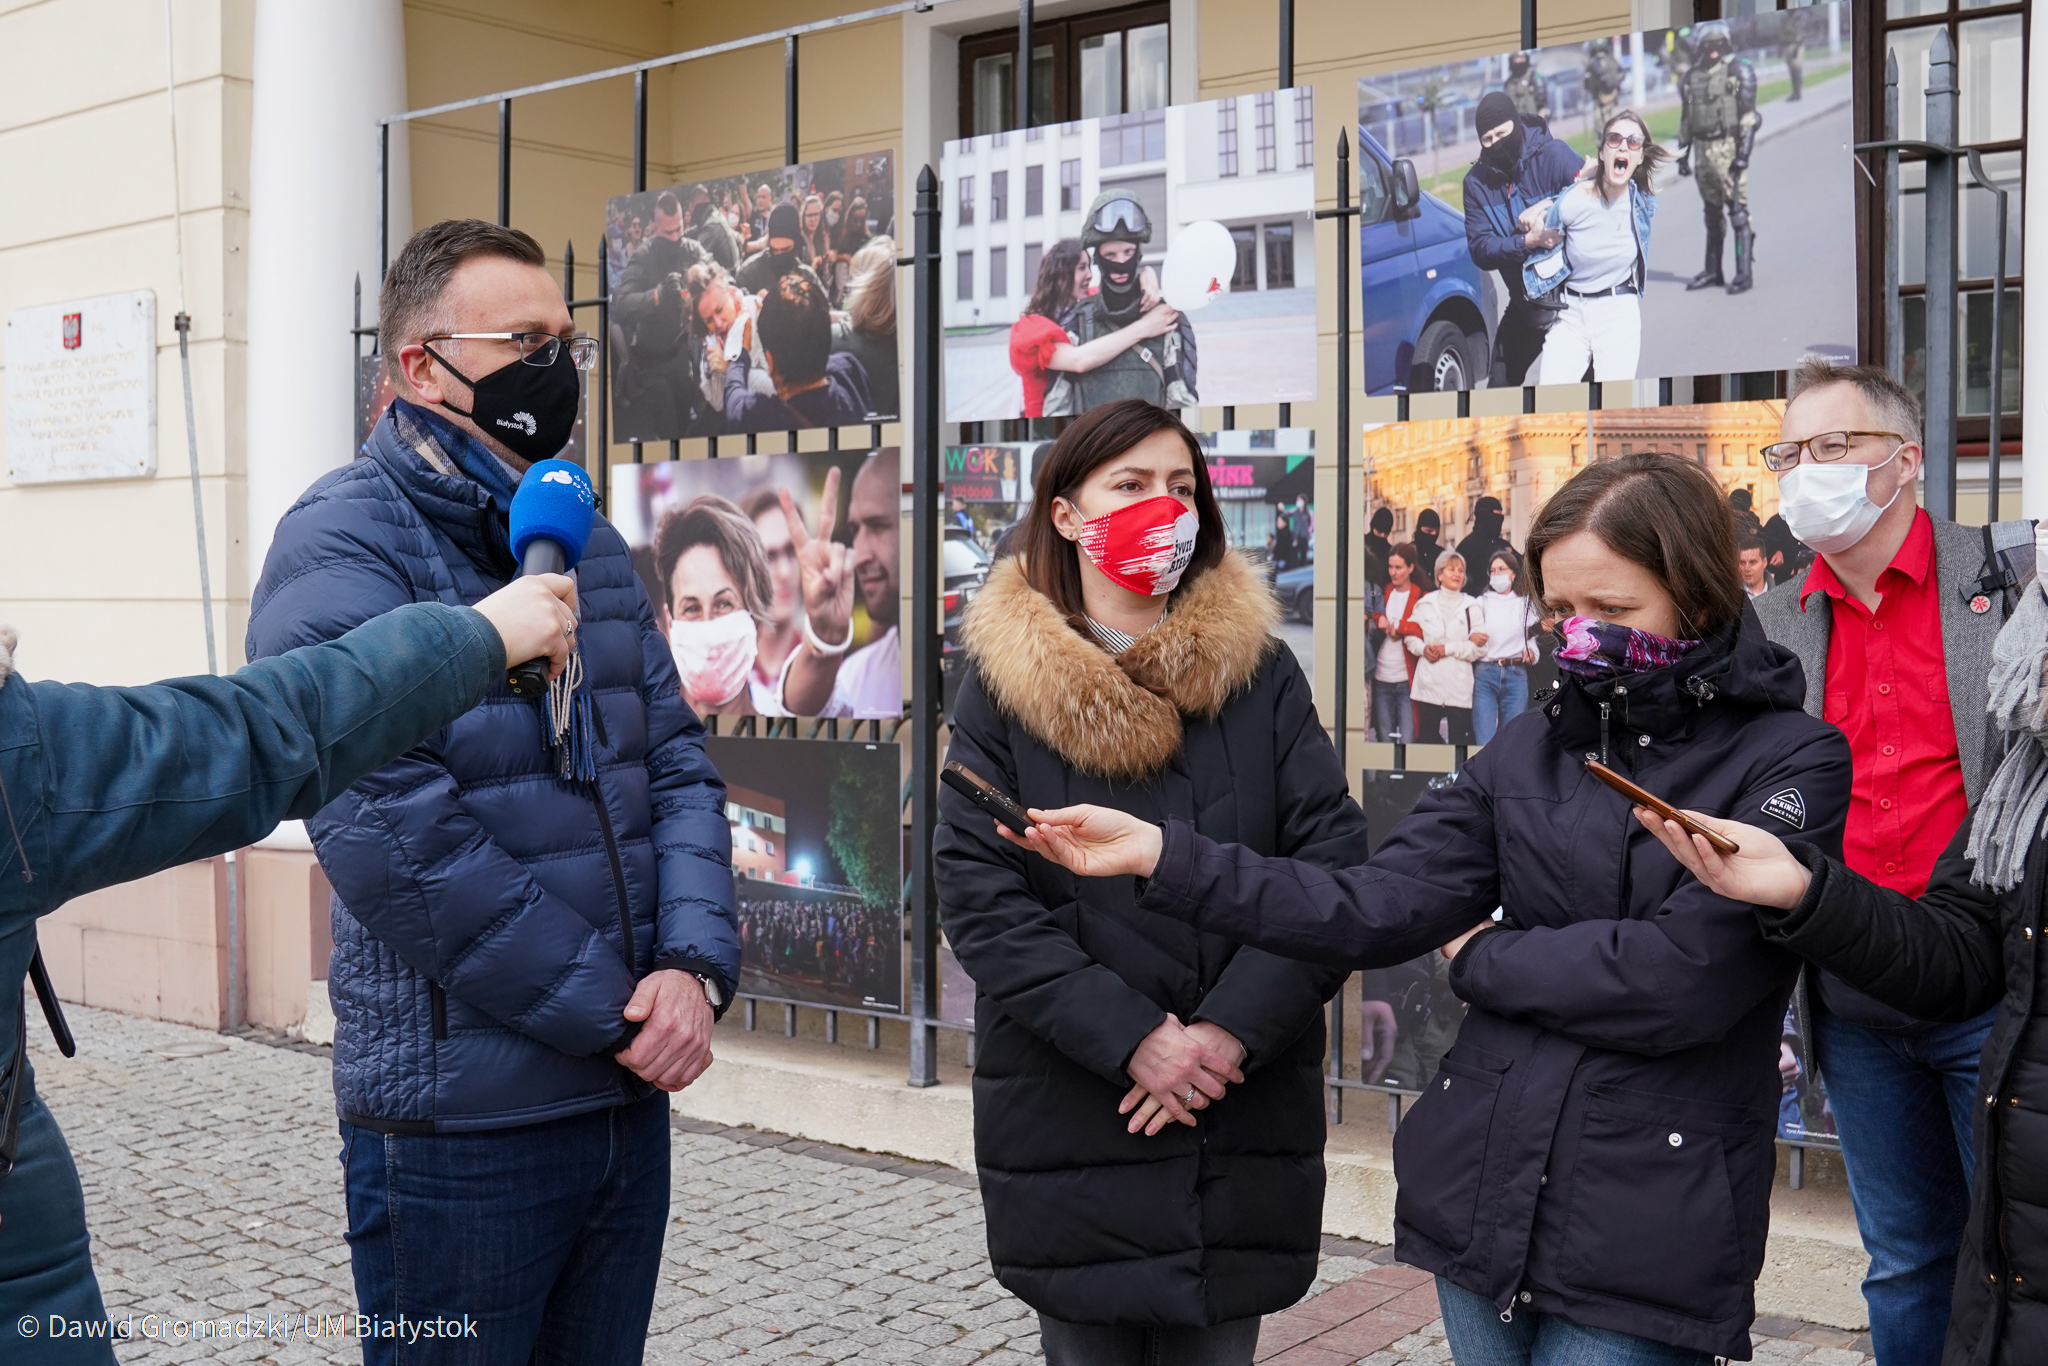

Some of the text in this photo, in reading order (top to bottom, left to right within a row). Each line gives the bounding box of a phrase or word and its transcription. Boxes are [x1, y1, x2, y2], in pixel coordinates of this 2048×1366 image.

[496, 418, 524, 431] Białystok
[945, 447, 999, 474] WOK
[1769, 806, 1785, 816] SINCE
